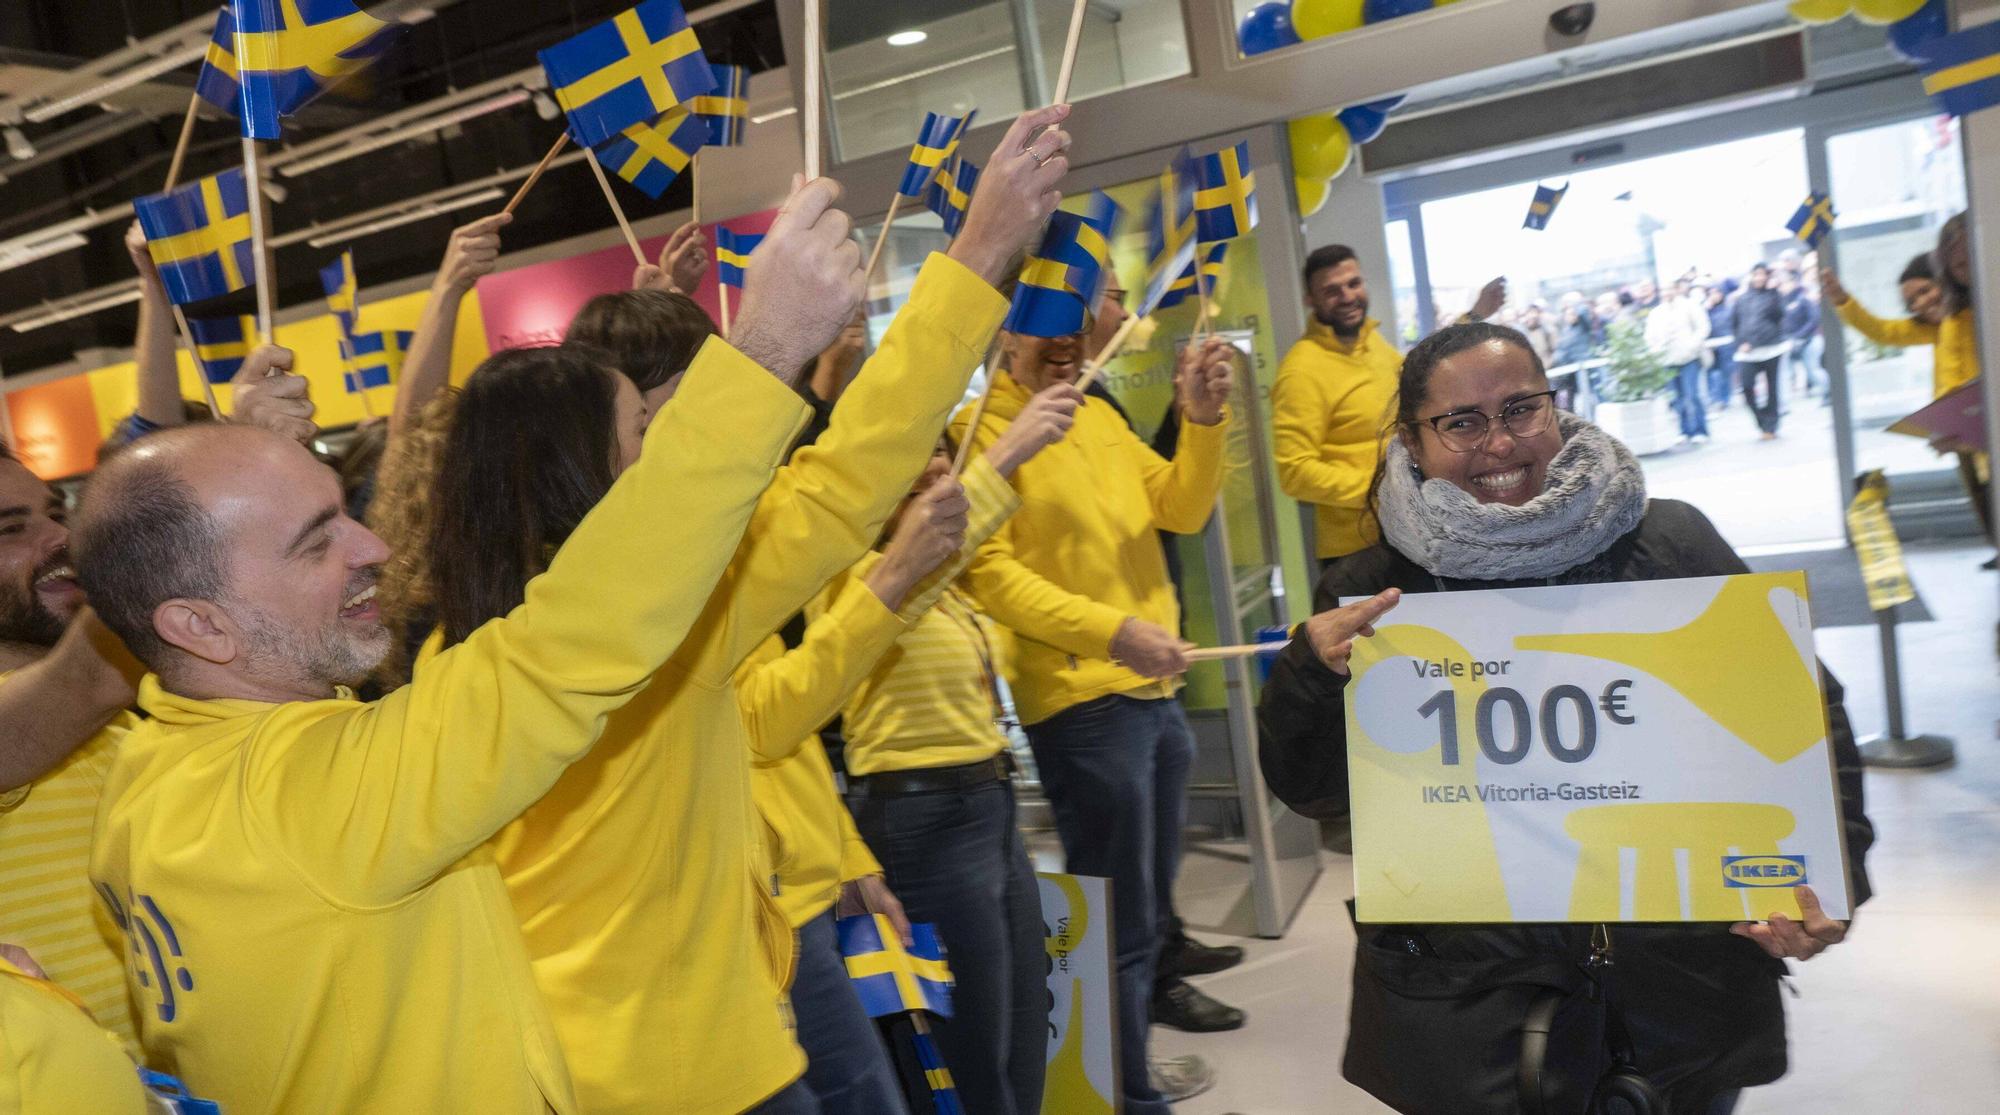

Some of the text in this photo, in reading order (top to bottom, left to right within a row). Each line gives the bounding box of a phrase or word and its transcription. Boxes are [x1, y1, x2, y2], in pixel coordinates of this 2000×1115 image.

[1412, 657, 1511, 682] Vale por
[1416, 679, 1635, 766] 100€
[1422, 780, 1641, 803] IKEA Vitoria-Gasteiz
[1730, 865, 1799, 877] IKEA
[1056, 917, 1069, 974] Vale por
